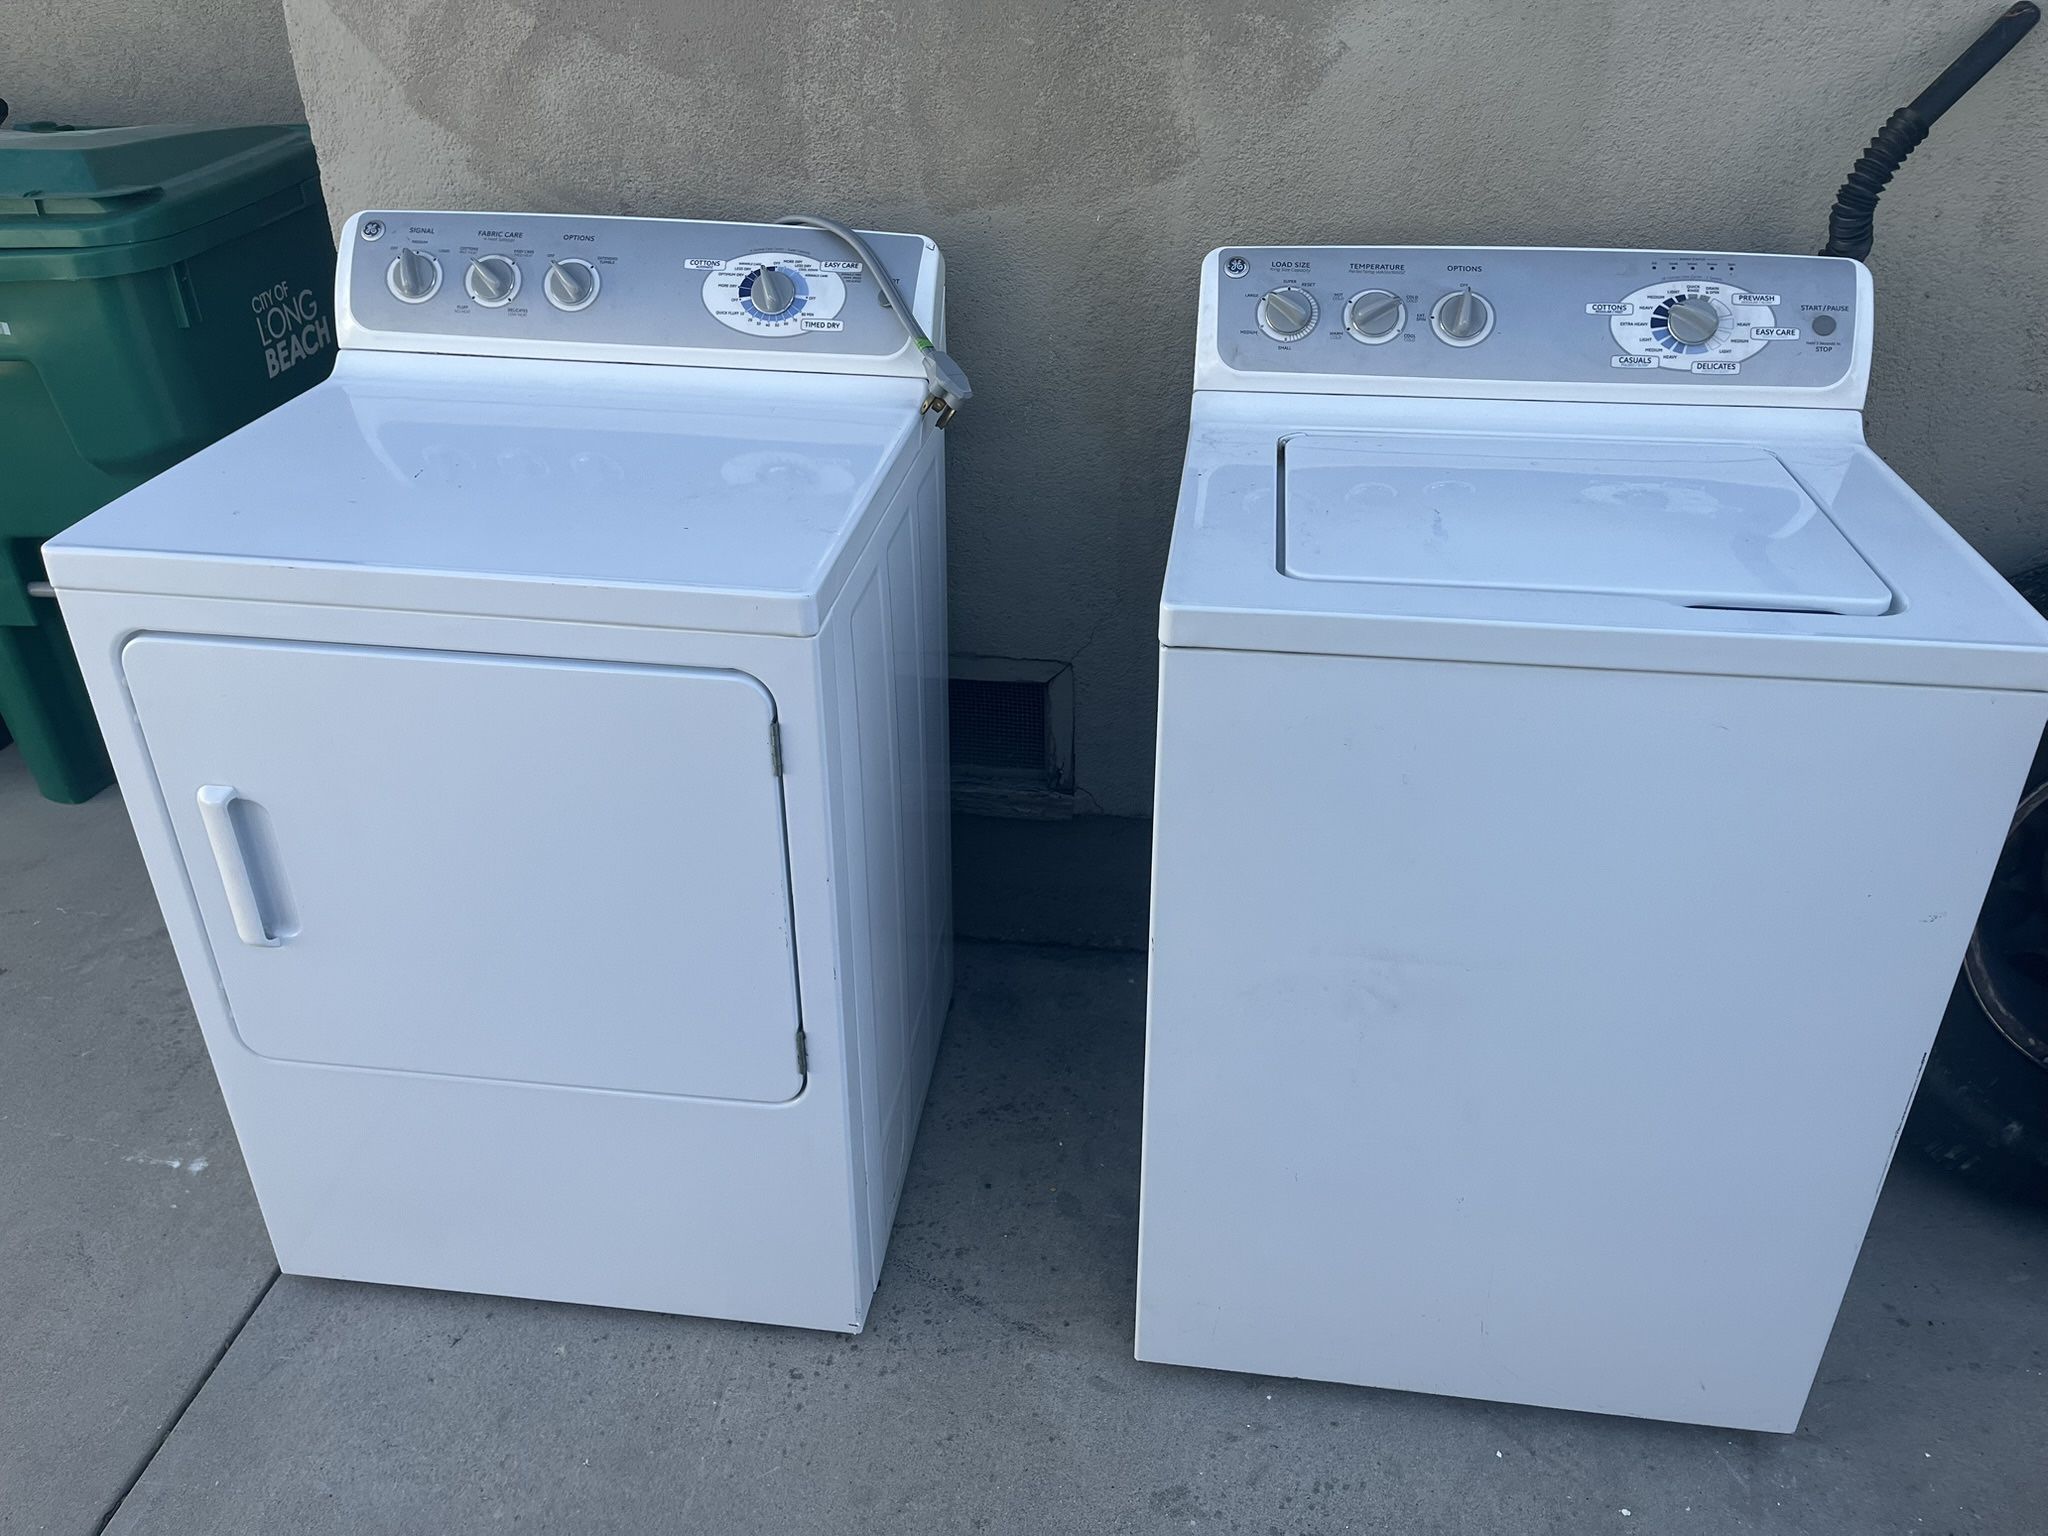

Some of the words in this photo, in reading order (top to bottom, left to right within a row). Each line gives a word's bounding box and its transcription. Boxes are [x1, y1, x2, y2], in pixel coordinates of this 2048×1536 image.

[409, 226, 434, 235] SIGNAL
[478, 229, 503, 239] FABRIC
[504, 231, 525, 240] CARE
[562, 233, 596, 242] OPTIONS
[690, 259, 721, 267] COTTONS
[824, 261, 841, 269] EASY
[841, 261, 859, 270] CARE
[1271, 261, 1293, 269] LOAD
[1294, 262, 1312, 270] SIZE
[1349, 263, 1405, 271] TEMPERATURE
[1447, 265, 1483, 273] OPTIONS
[251, 289, 274, 313] CITY
[274, 280, 289, 301] OF
[1738, 294, 1775, 303] PREWASH
[1800, 304, 1849, 312] START/PAUSE
[256, 289, 318, 346] LONG
[804, 320, 826, 328] TIMED
[826, 321, 841, 330] DRY
[1755, 328, 1774, 337] EASY
[1775, 329, 1796, 337] CARE
[264, 315, 332, 379] BEACH
[1618, 356, 1652, 364] CASUALS
[1696, 362, 1736, 371] DELICATES
